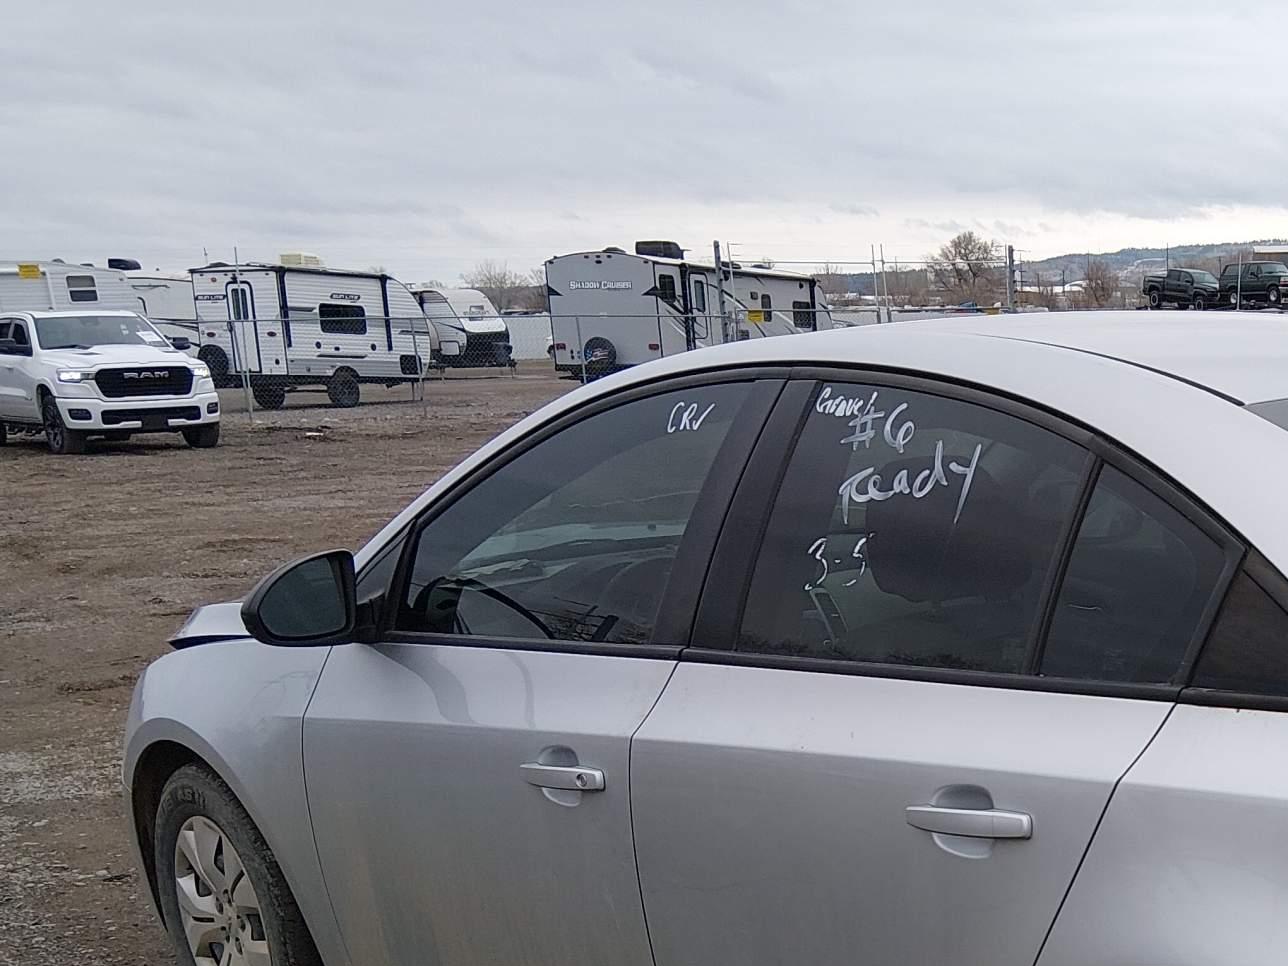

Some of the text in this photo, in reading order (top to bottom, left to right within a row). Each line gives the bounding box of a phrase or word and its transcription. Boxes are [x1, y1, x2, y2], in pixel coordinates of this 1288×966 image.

[569, 281, 632, 289] SHADOW CRUISER
[123, 371, 169, 379] RAM
[840, 402, 915, 453] #6
